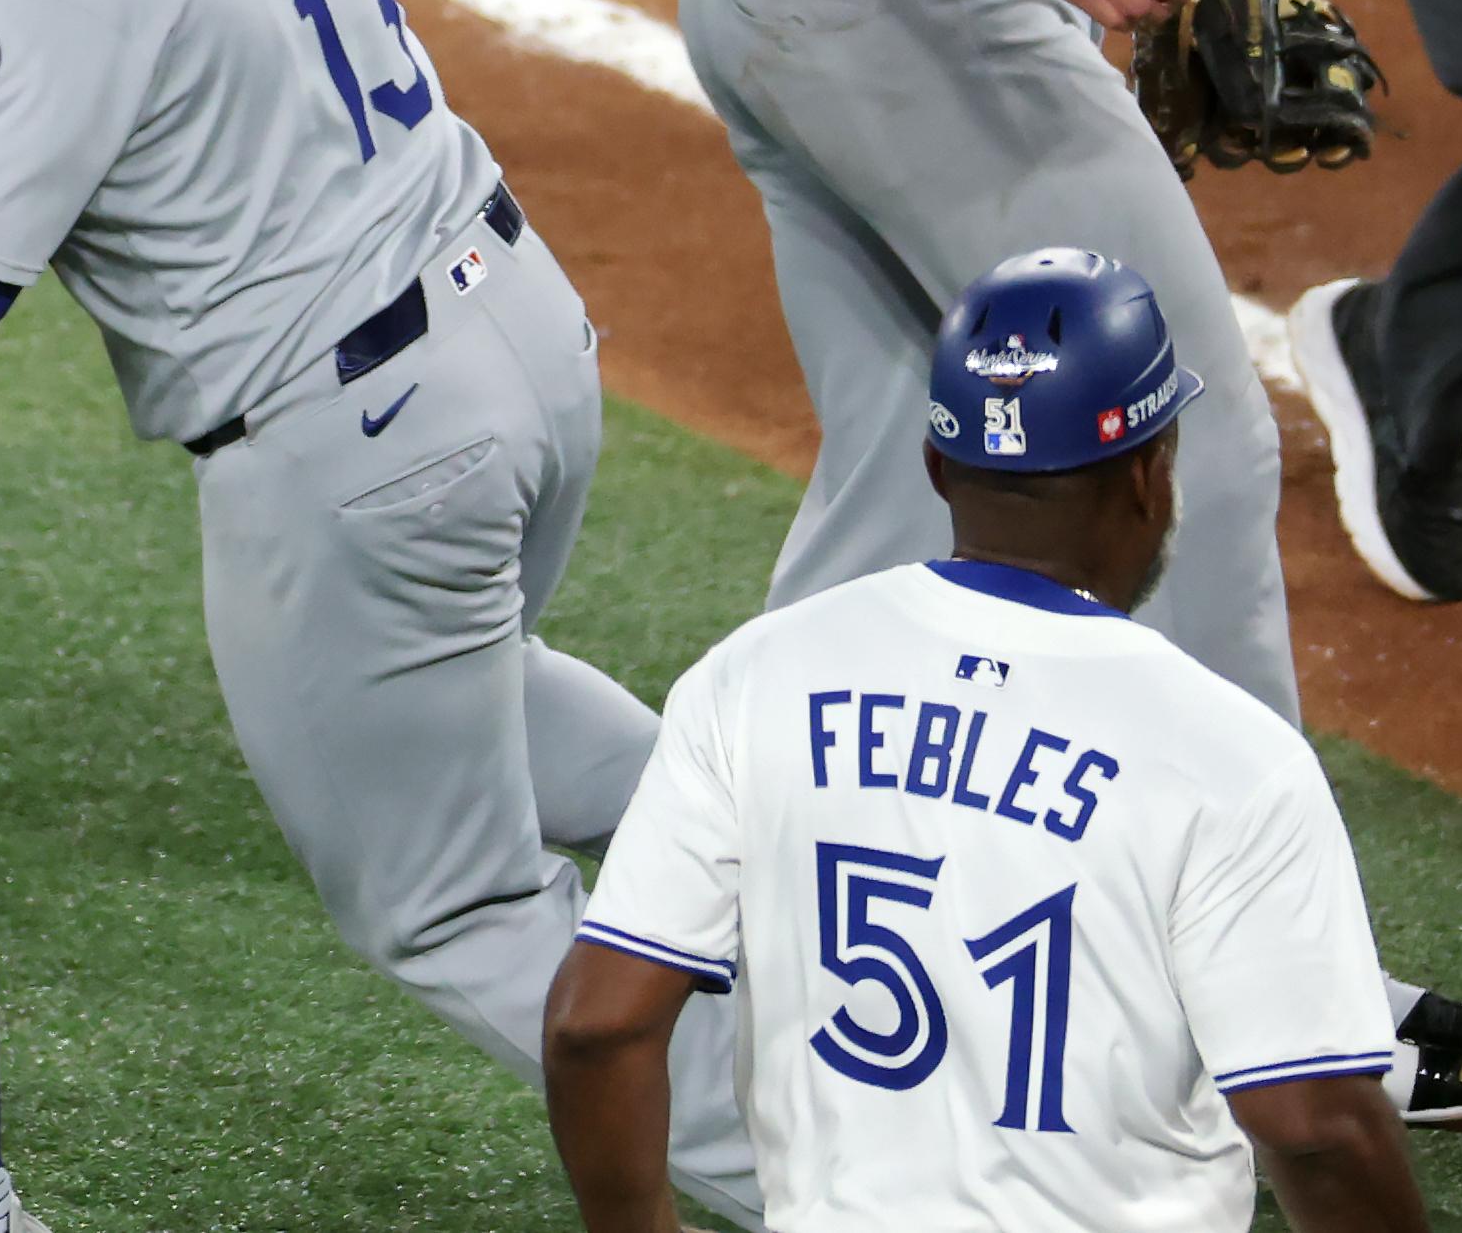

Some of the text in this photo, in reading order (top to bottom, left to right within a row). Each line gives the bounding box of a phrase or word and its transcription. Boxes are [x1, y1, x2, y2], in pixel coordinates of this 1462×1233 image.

[984, 396, 1022, 434] 51
[808, 689, 1120, 843] FEBLES
[808, 840, 1078, 1135] 51
